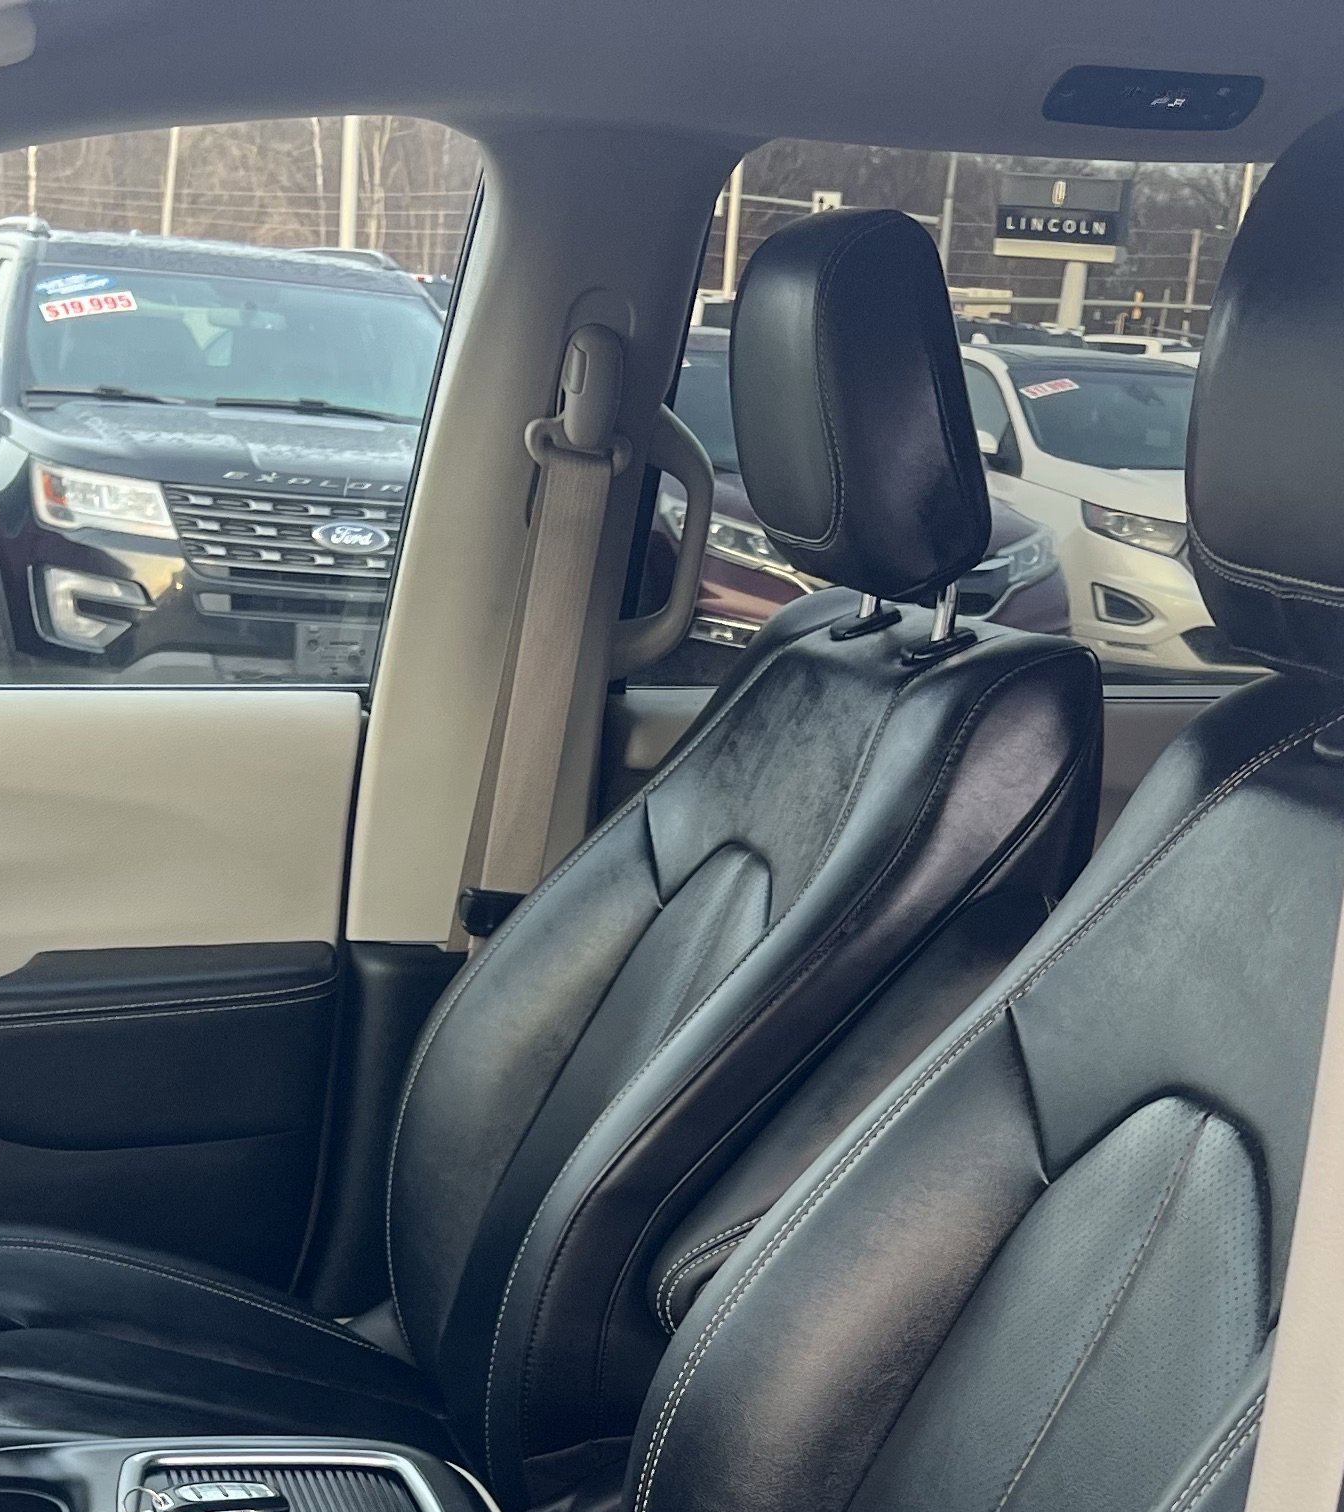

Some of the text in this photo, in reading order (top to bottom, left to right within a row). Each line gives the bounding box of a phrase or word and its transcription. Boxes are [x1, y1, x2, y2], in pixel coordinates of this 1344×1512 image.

[1005, 216, 1106, 235] LINCOLN
[222, 471, 405, 493] EXPLOR
[330, 526, 374, 546] Ford
